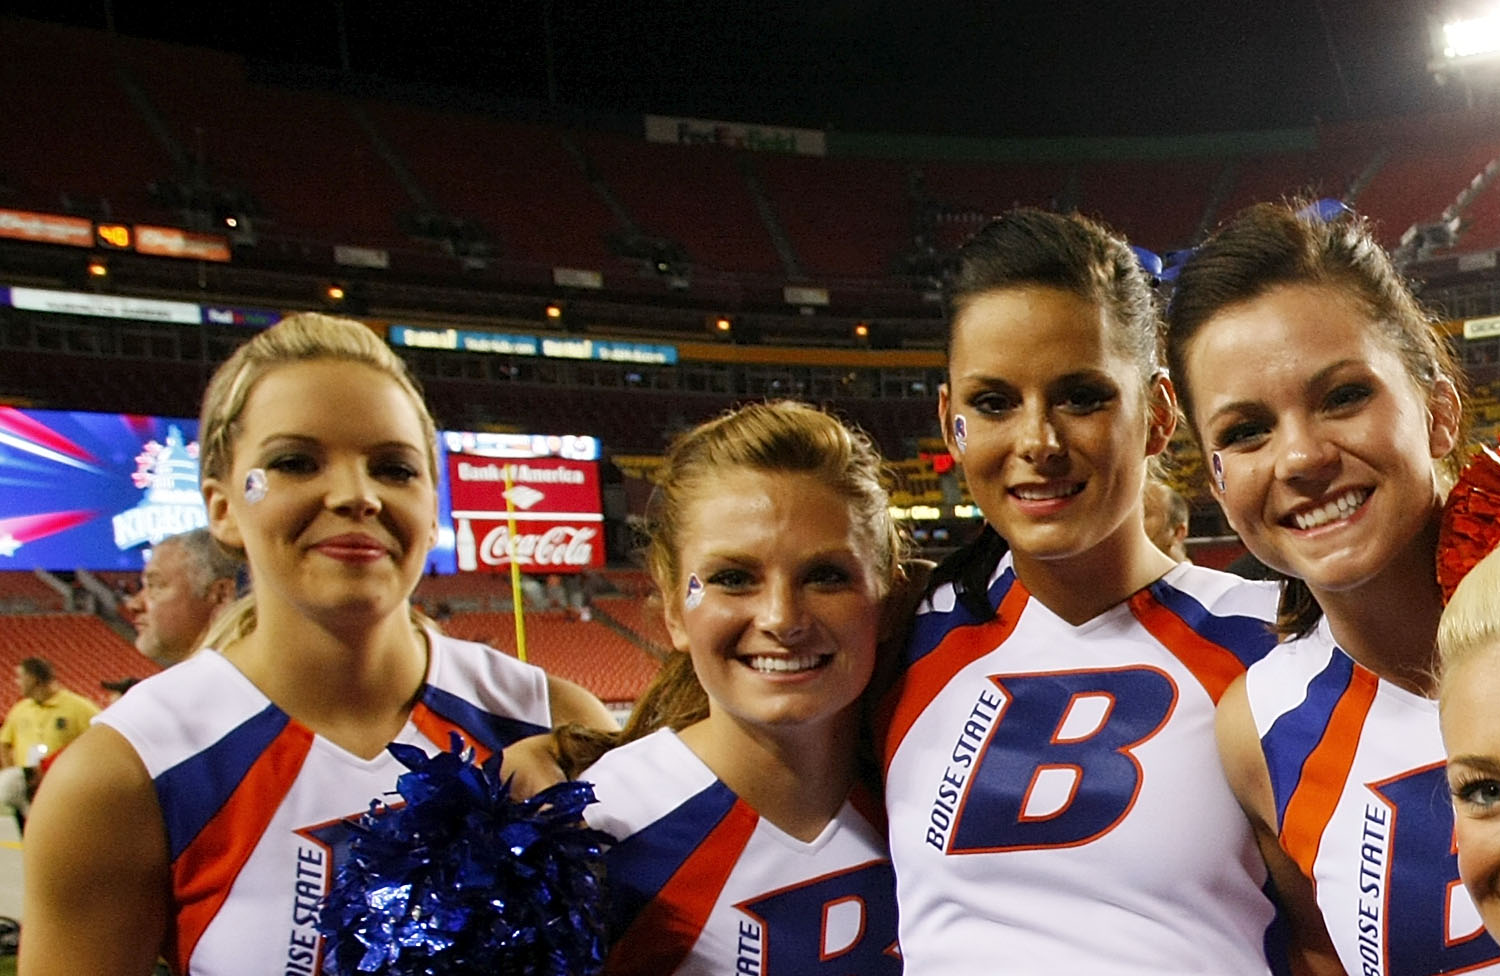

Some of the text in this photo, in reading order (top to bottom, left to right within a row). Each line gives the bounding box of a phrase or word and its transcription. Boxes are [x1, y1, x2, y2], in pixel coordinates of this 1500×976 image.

[458, 462, 499, 482] Bank
[519, 463, 586, 485] America
[926, 689, 1000, 851] BOISE STATE
[986, 664, 1179, 855] B
[293, 846, 324, 929] STATE
[1360, 803, 1387, 898] STATE
